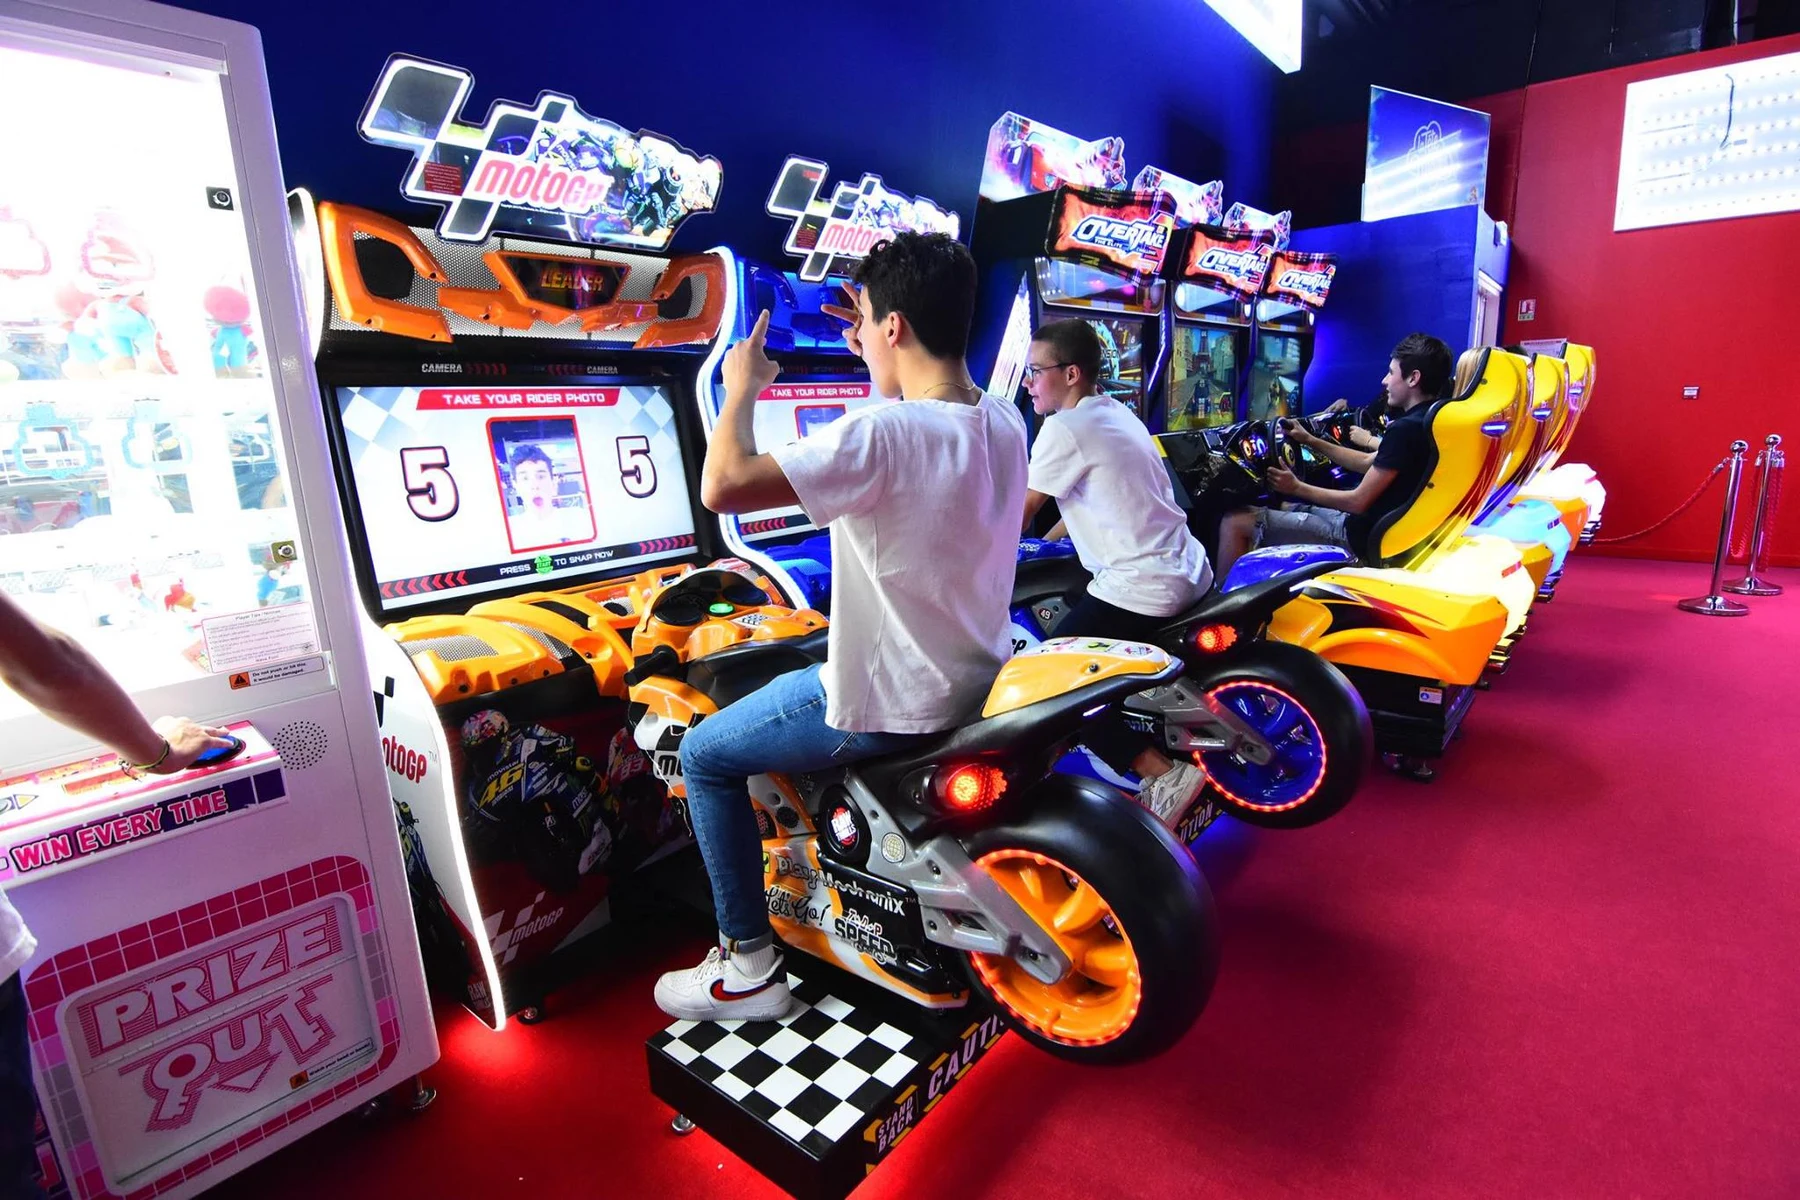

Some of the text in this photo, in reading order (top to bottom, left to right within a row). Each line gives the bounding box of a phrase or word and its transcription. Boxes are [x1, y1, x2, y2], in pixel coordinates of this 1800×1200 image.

[1077, 219, 1165, 250] OVERTAKE
[421, 363, 618, 375] CAMERA CAMERA
[442, 392, 604, 405] TAKE YOUR RIDER PHOTO
[770, 387, 864, 397] TAKE YOUR RIDER PHOTO
[400, 446, 460, 521] 5
[616, 435, 657, 498] 5
[499, 563, 531, 576] PRESS
[554, 558, 567, 566] TO
[569, 554, 592, 564] SNAP
[595, 550, 614, 560] NOW
[1040, 609, 1051, 620] 49
[478, 762, 525, 809] 46
[14, 790, 228, 872] WIN EVERY TIME
[834, 917, 898, 959] SPEED
[84, 907, 340, 1056] PRIZE
[138, 978, 332, 1128] OUT
[878, 1096, 913, 1139] STAND
[878, 1108, 914, 1154] BACK
